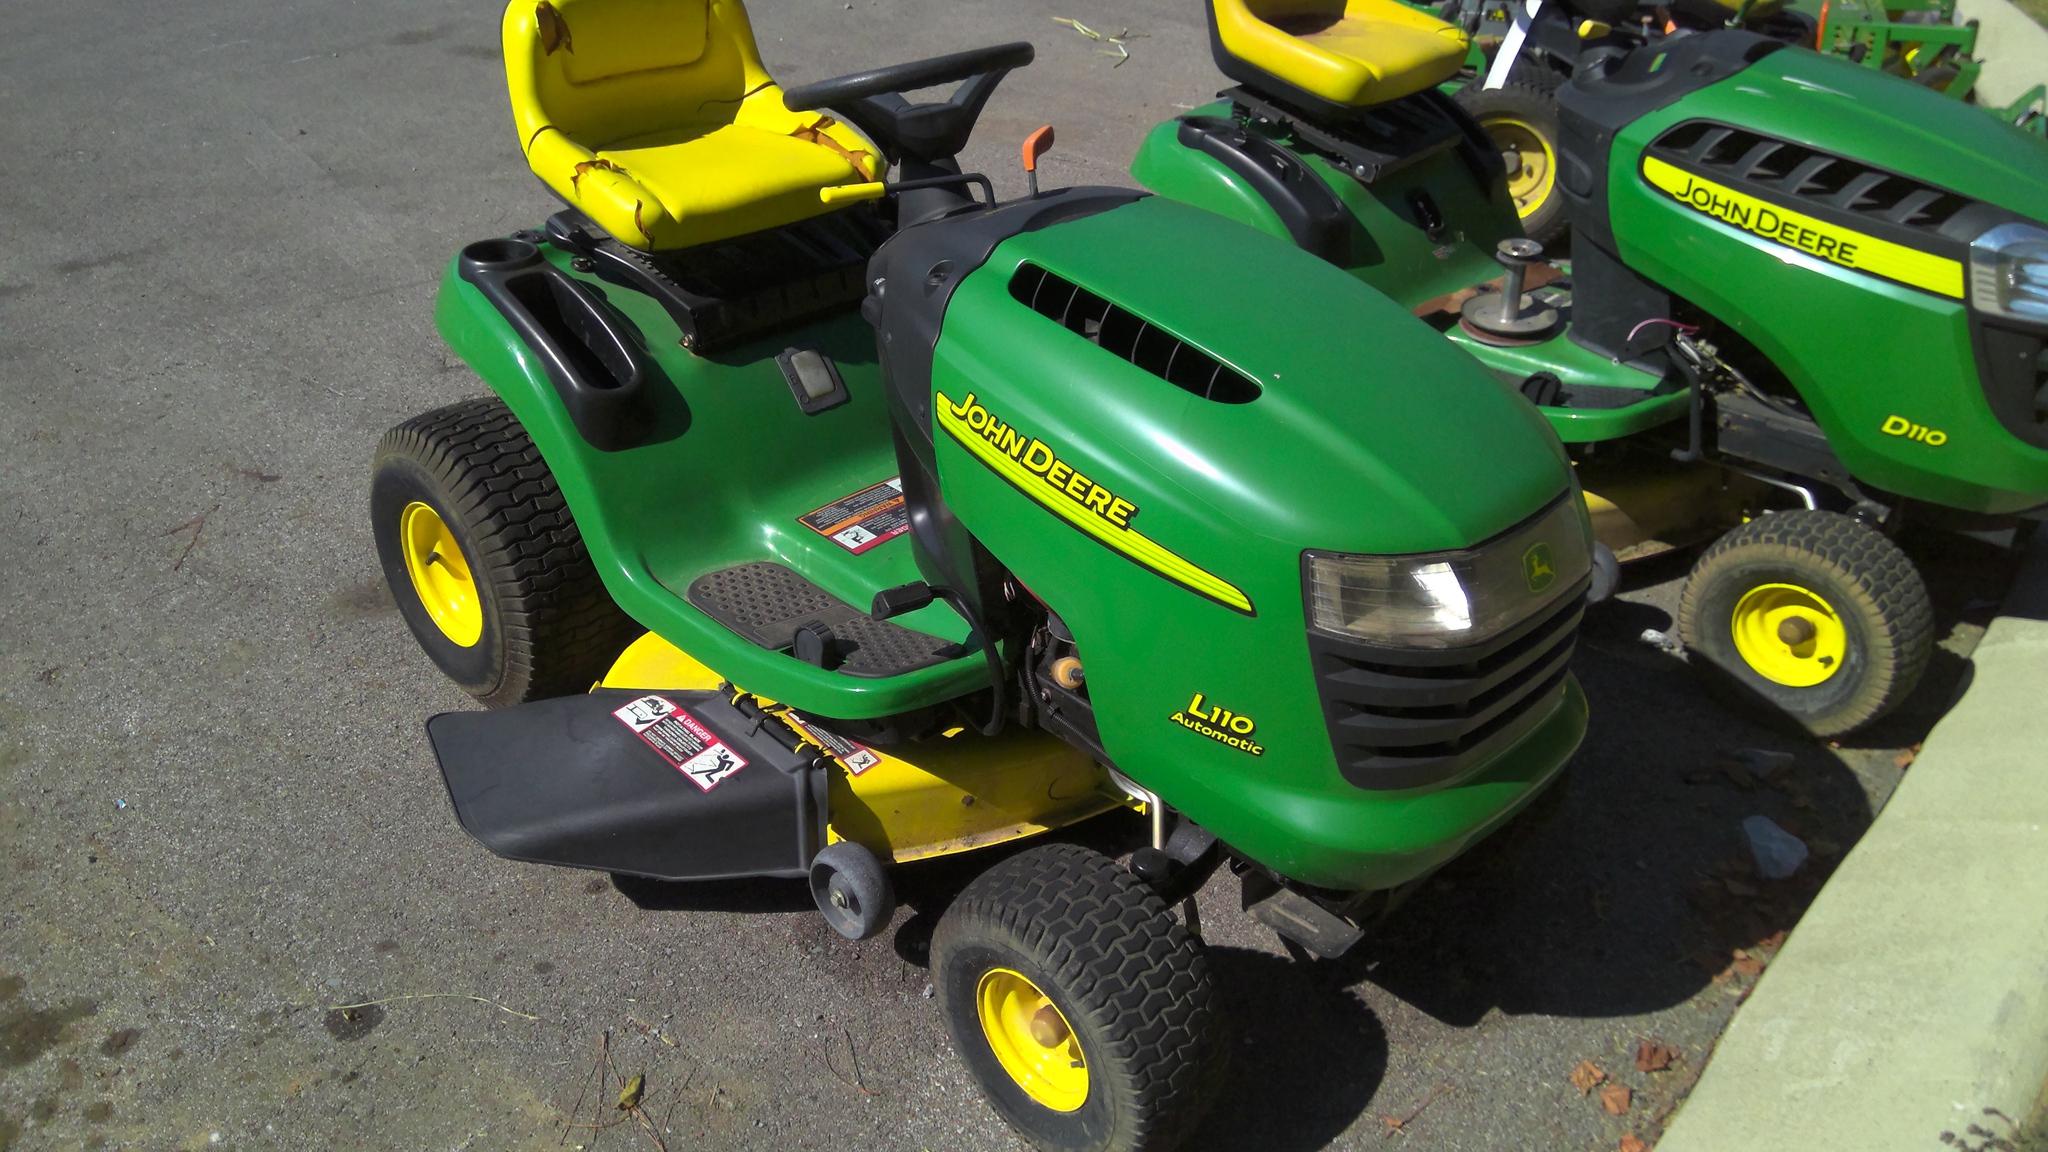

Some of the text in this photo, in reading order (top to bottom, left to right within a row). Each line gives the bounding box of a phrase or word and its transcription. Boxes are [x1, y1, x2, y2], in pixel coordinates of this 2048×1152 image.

[1676, 178, 1858, 264] JOHN DEERE
[1880, 414, 1947, 446] D110
[950, 391, 1137, 527] JOHN DEERE
[683, 718, 712, 742] DANGER
[1170, 712, 1263, 755] Automatic
[1187, 693, 1254, 734] L110
